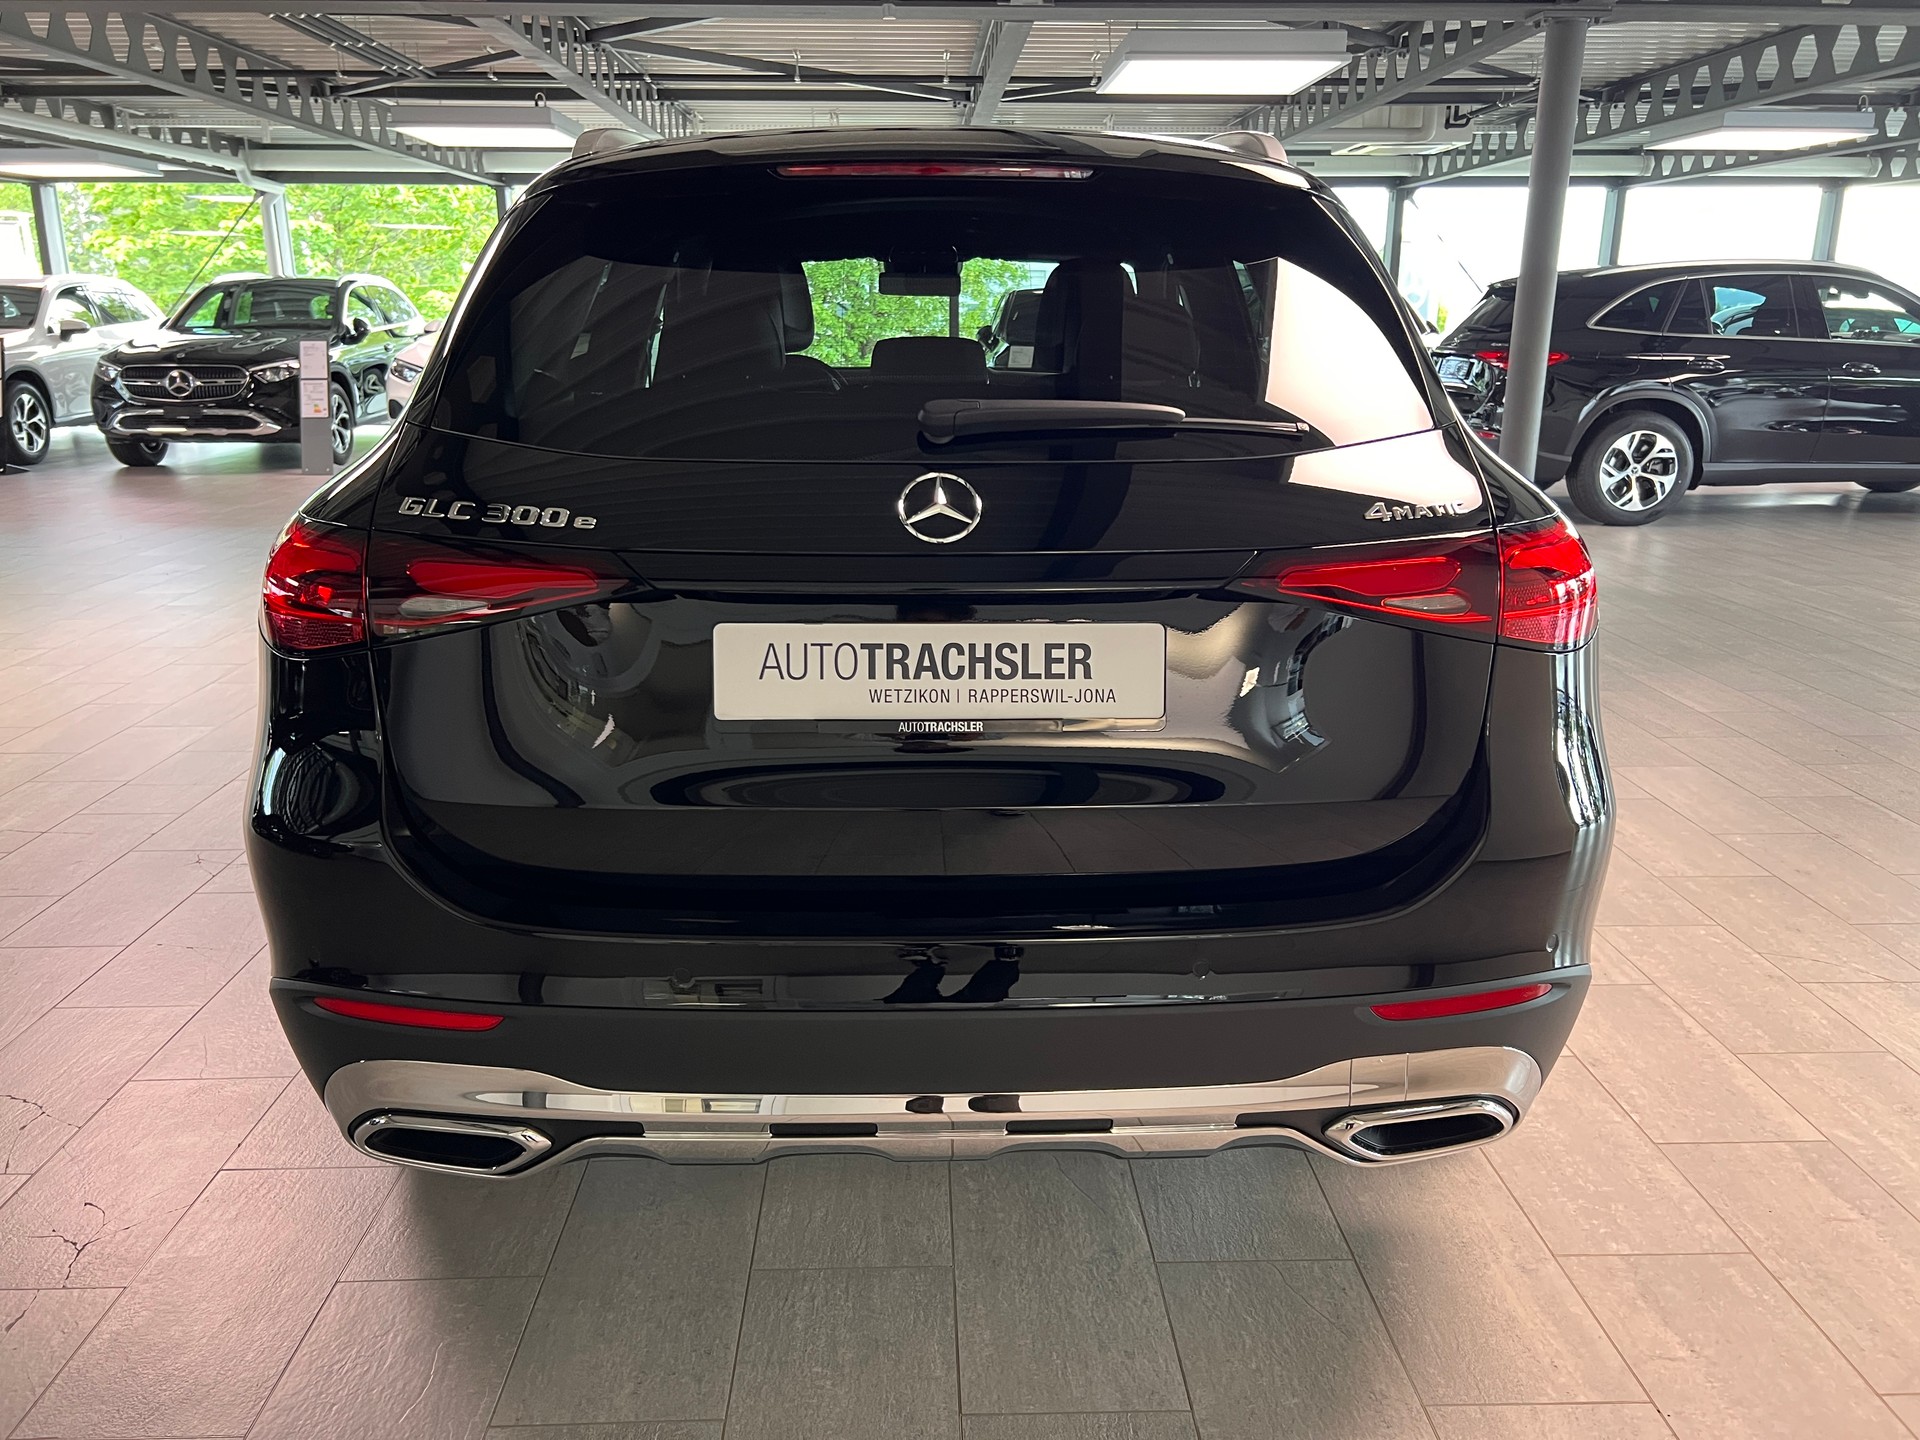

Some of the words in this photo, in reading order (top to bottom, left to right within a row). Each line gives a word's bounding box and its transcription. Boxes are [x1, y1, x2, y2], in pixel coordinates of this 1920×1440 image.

[399, 496, 476, 520] GLC
[759, 642, 1093, 681] AUTOTRACHSLER
[868, 688, 950, 704] WETZIKON
[968, 688, 1117, 704] RAPPERSWIL-JONA
[898, 721, 984, 733] AUTOTRACHSLER
